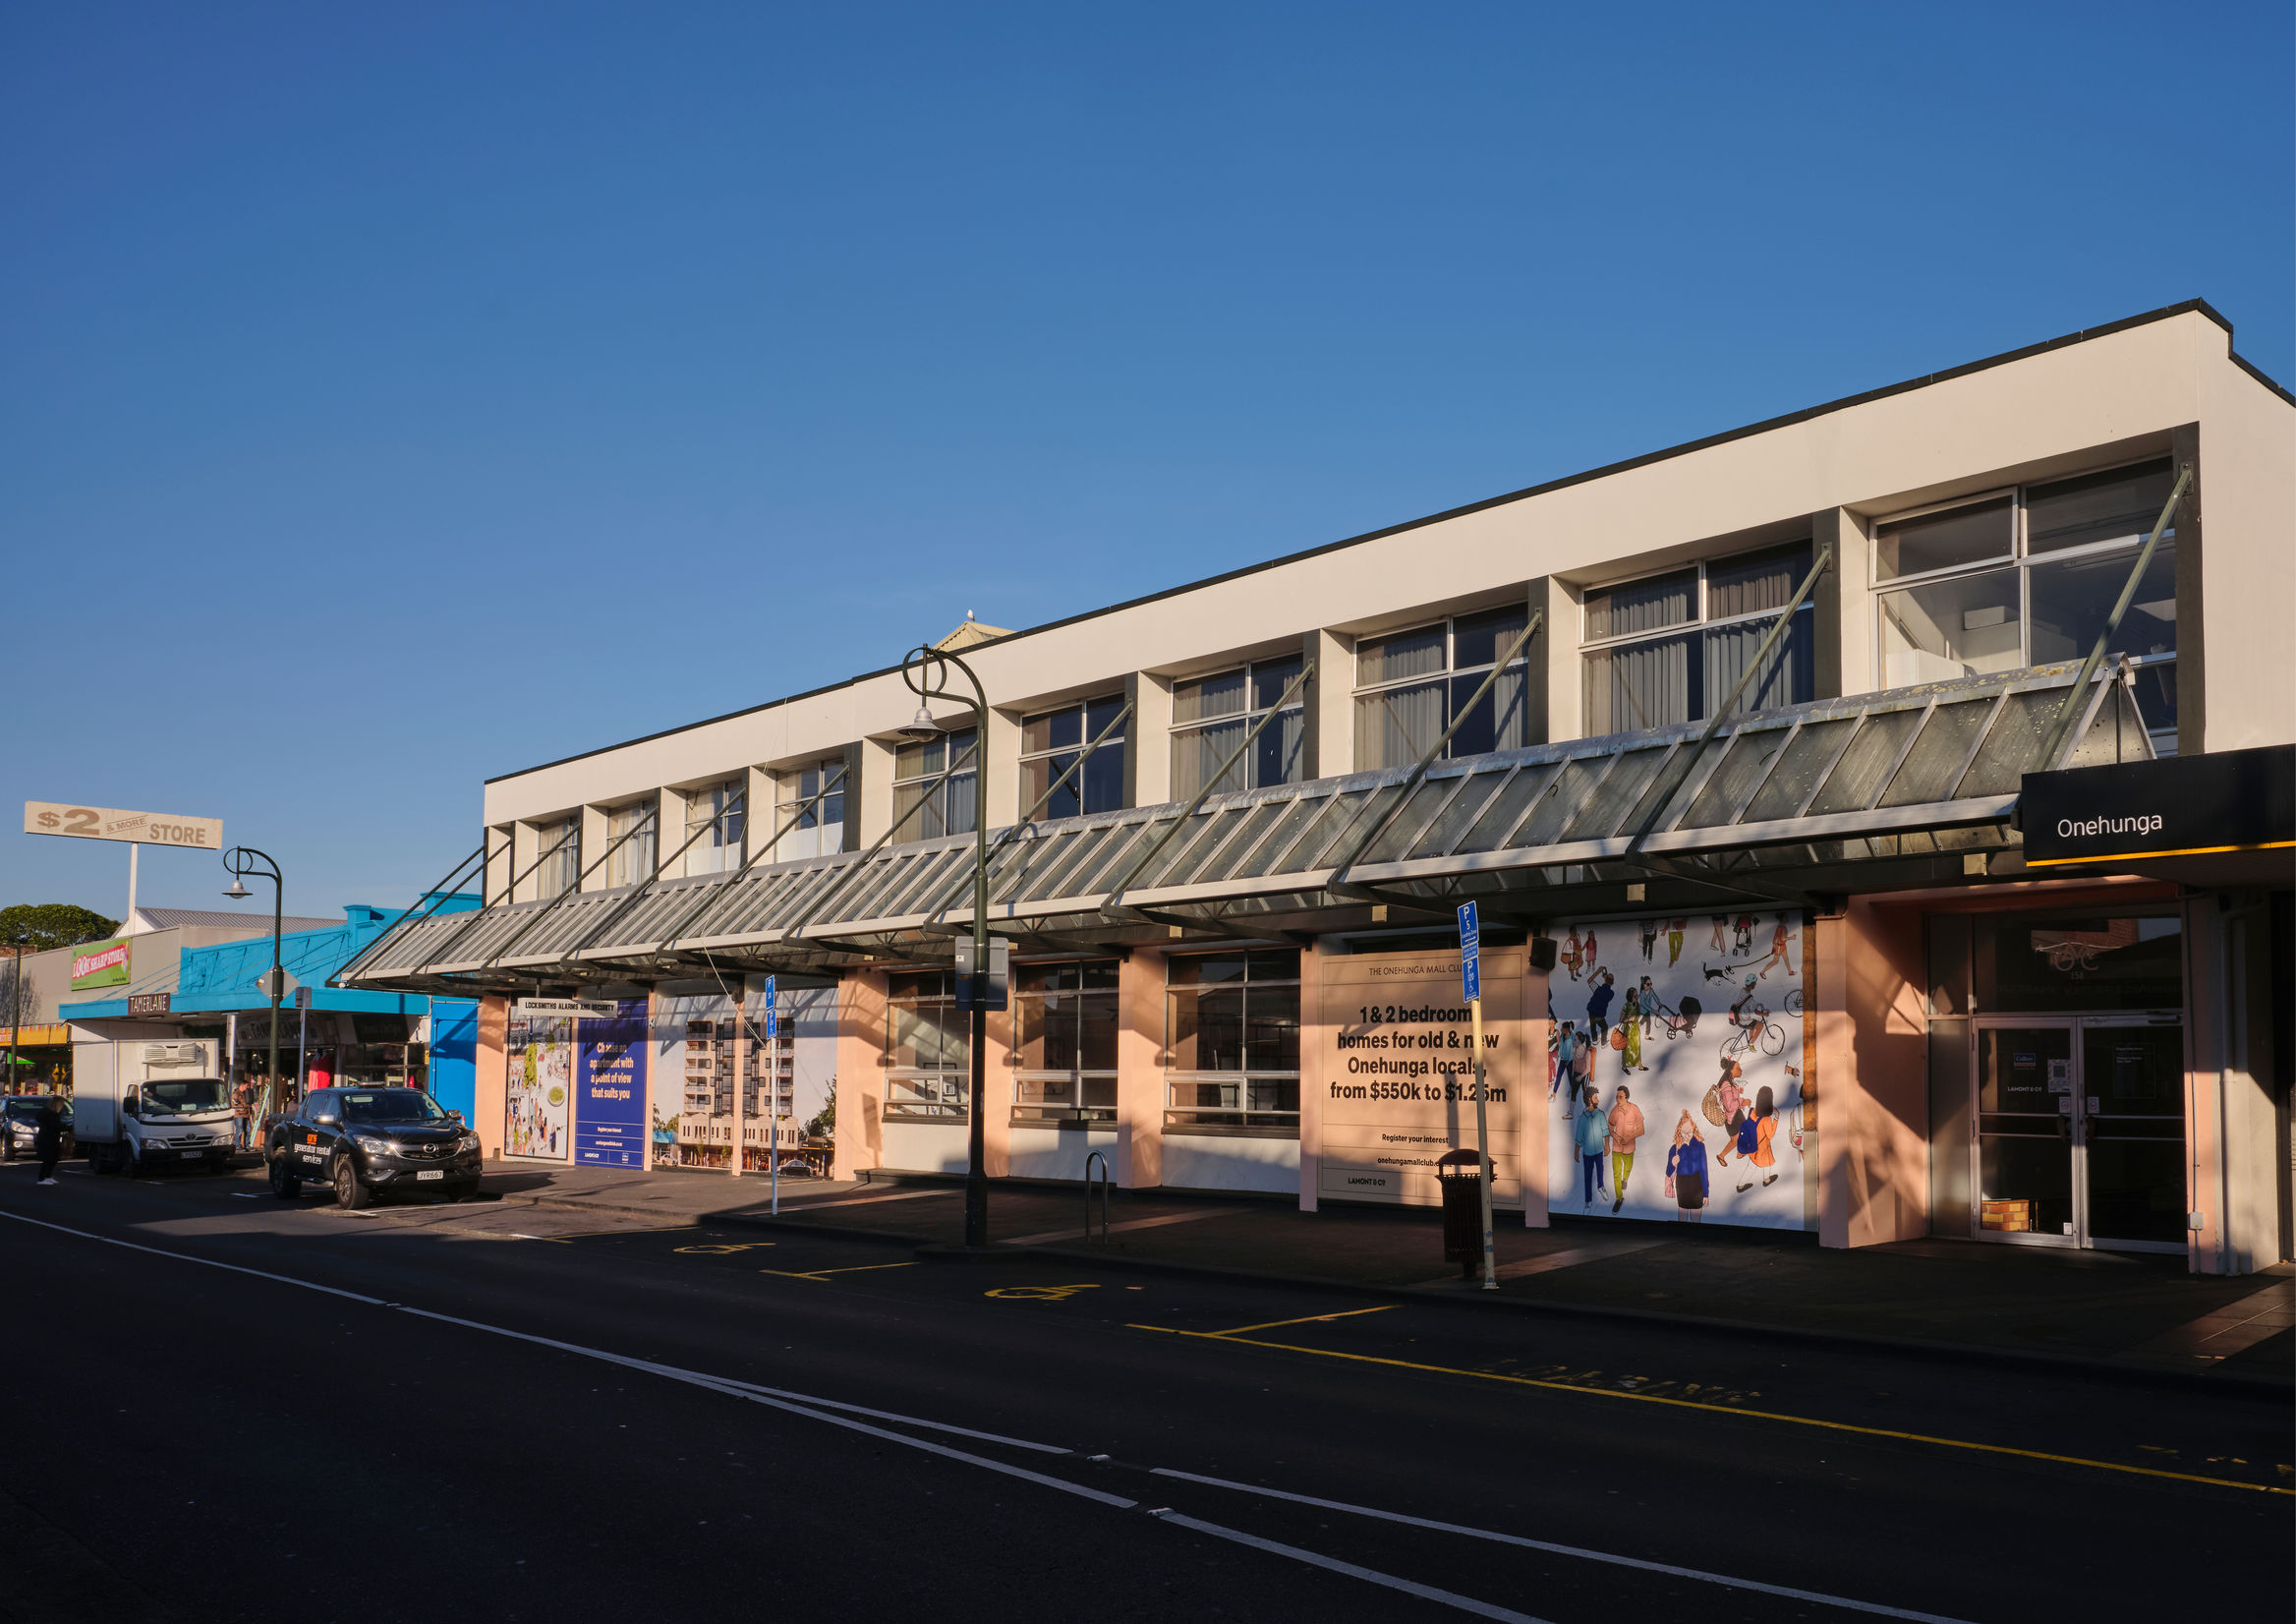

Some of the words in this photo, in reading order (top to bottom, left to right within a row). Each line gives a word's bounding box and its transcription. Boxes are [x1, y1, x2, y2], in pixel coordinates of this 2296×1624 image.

[37, 808, 100, 836] $2
[116, 817, 147, 830] MORE
[149, 823, 206, 843] STORE
[2057, 814, 2162, 838] Onehunga
[1464, 906, 1470, 919] P
[1466, 920, 1470, 930] 5
[73, 956, 90, 977] LOOK
[90, 953, 108, 970] SHARP
[1383, 965, 1424, 975] ONEHUNGA
[1467, 961, 1473, 973] P
[130, 995, 167, 1013] TAMERLANE
[1360, 1007, 1367, 1022] 1
[1370, 1007, 1383, 1022] &
[1386, 1007, 1396, 1022] 2
[1400, 1005, 1472, 1022] bedroom
[1338, 1032, 1389, 1049] homes
[1392, 1031, 1414, 1048] for
[1418, 1031, 1444, 1048] old
[1447, 1031, 1460, 1048] &
[1464, 1034, 1499, 1048] nw
[597, 1042, 618, 1053] Choose
[619, 1044, 627, 1053] an
[590, 1059, 620, 1071] apartment
[620, 1058, 634, 1069] with
[1348, 1057, 1429, 1077] Onehunga
[596, 1073, 610, 1085] point
[610, 1073, 617, 1083] of
[618, 1073, 632, 1083] view
[592, 1087, 603, 1098] that
[604, 1087, 618, 1099] suits
[618, 1091, 630, 1101] you
[1331, 1081, 1366, 1099] from
[1370, 1080, 1420, 1101] $550k
[1424, 1084, 1441, 1100] to
[294, 1143, 316, 1153] generator
[316, 1146, 331, 1156] rental
[303, 1154, 322, 1164] services
